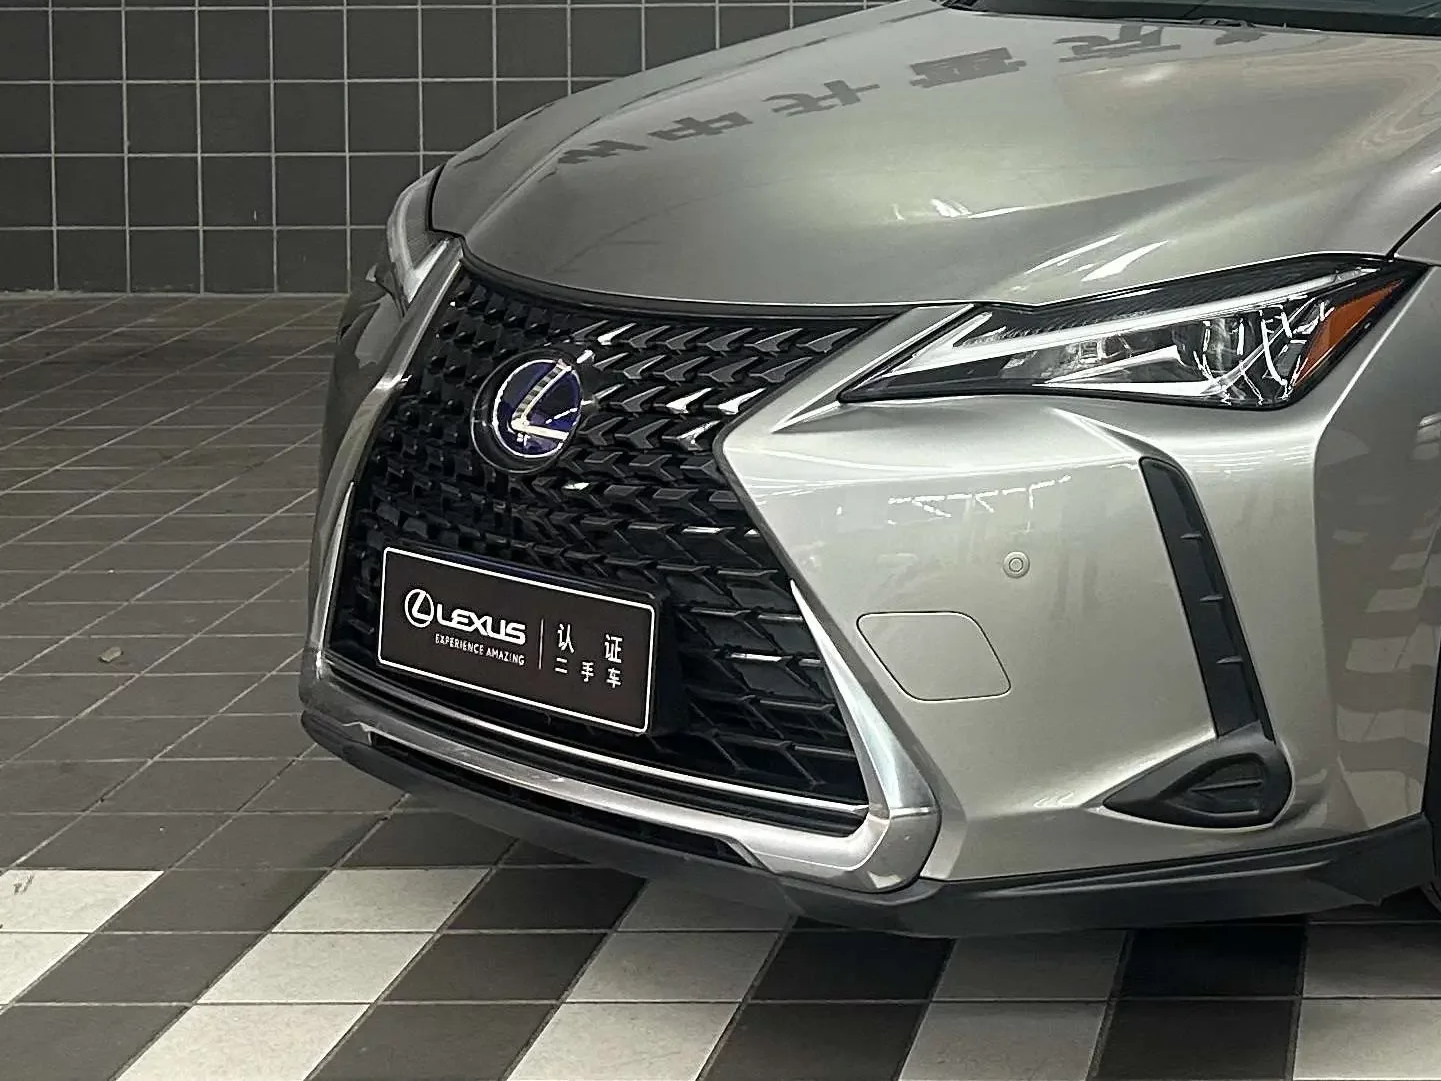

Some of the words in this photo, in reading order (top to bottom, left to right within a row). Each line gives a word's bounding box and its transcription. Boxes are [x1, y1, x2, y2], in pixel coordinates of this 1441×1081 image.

[436, 603, 526, 645] LEXUS
[435, 632, 485, 656] EXPERIENCE
[486, 647, 526, 666] AMAZING
[557, 623, 623, 664] 认证
[555, 657, 622, 688] 二手车
